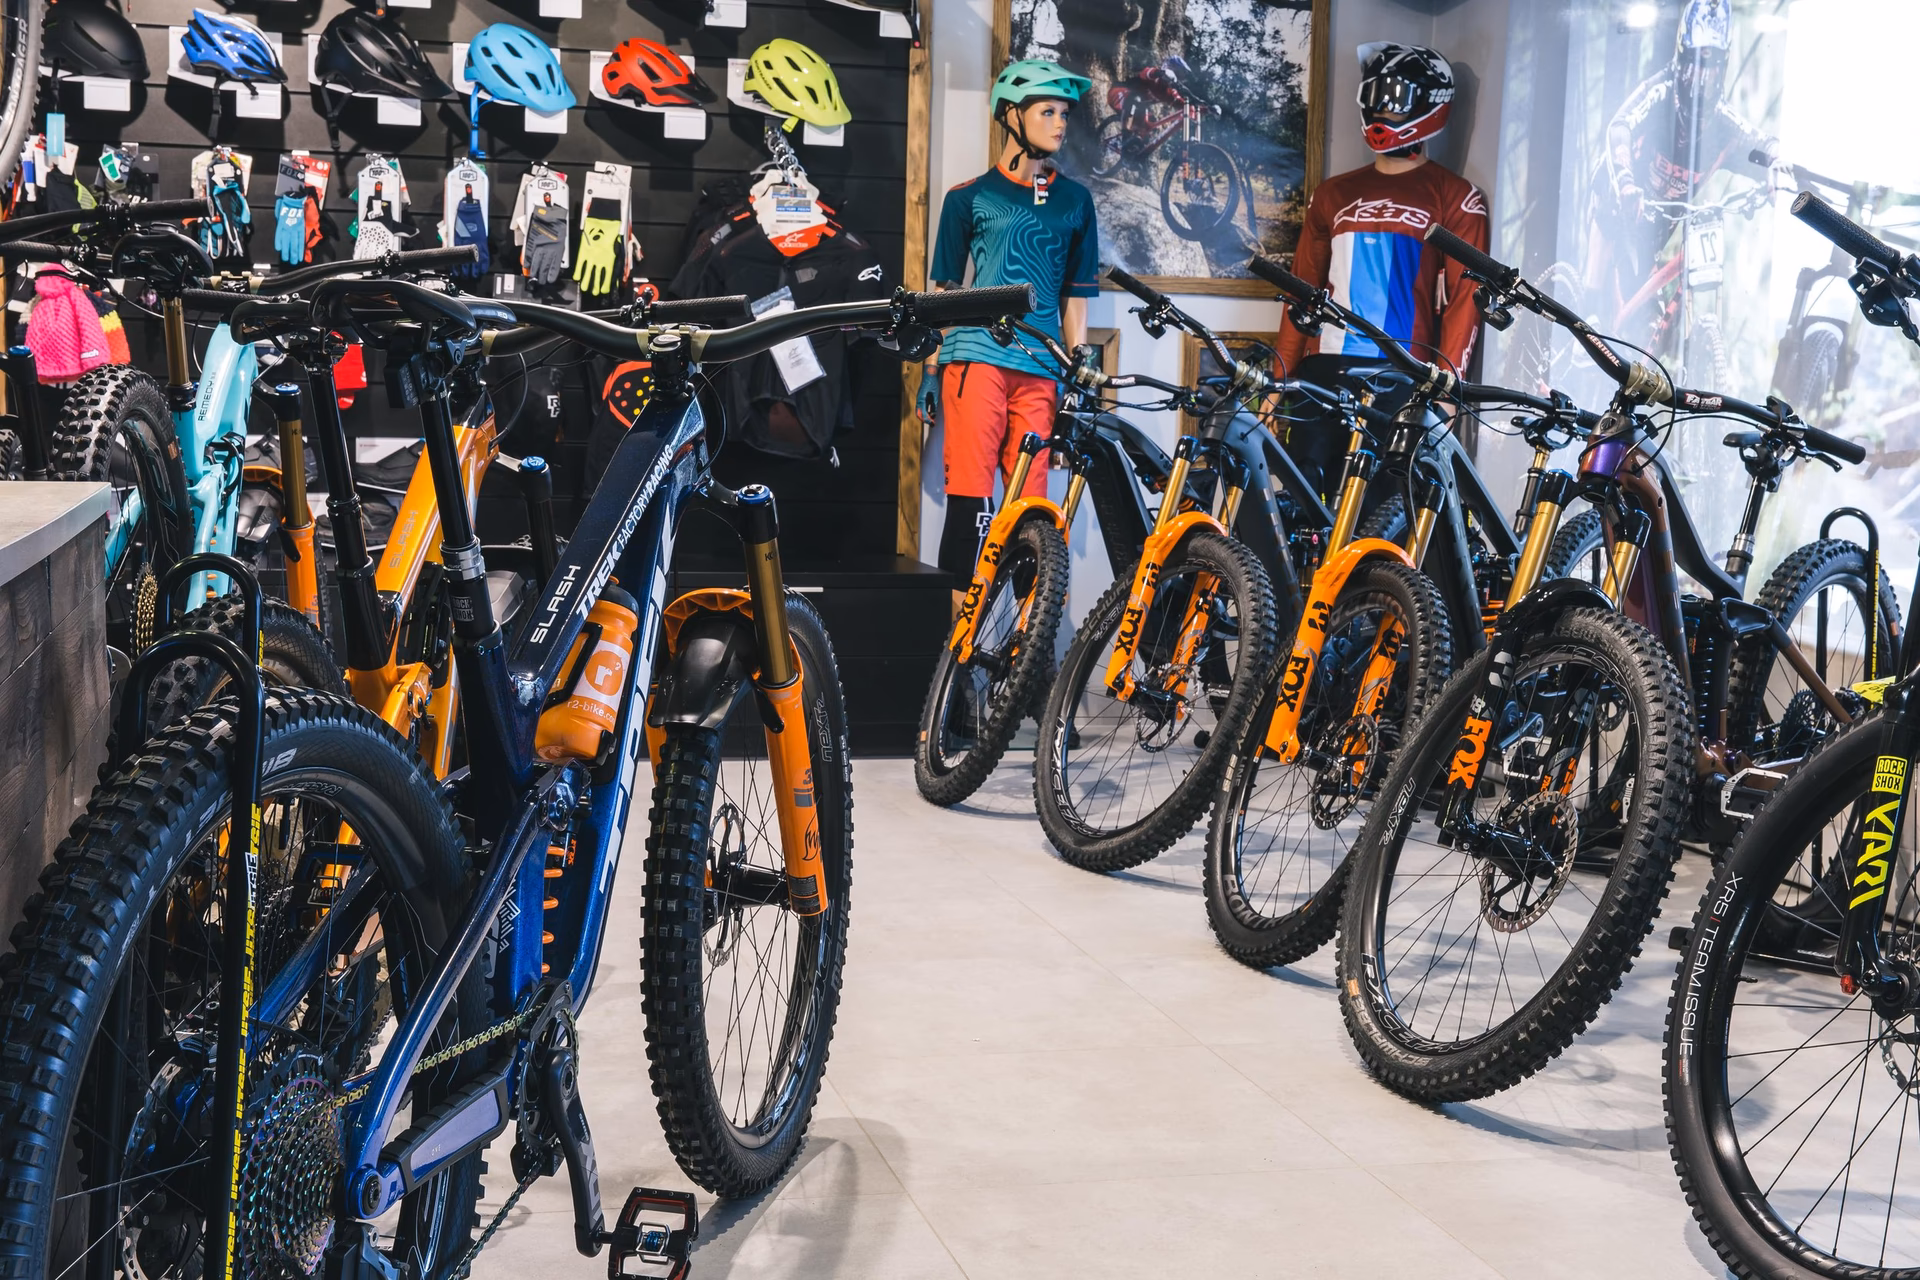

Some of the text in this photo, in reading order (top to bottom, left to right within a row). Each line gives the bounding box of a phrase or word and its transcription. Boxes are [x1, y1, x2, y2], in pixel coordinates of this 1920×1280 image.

[280, 166, 298, 178] FOX
[279, 206, 304, 218] FOX
[197, 380, 215, 422] REMEDY
[388, 509, 419, 569] SLASH
[576, 444, 675, 621] TREK FACTORY RACING
[530, 565, 582, 645] SLASH
[959, 583, 984, 625] FOX
[1080, 577, 1135, 645] SCHWAL
[1114, 606, 1144, 656] FOX
[1275, 654, 1311, 713] FOX
[1447, 715, 1493, 790] FOX
[1876, 758, 1905, 776] ROCK
[1874, 774, 1902, 791] SHOX
[567, 839, 577, 867] FOX
[1849, 800, 1901, 911] YARI
[1713, 870, 1744, 918] XR5
[1689, 924, 1721, 988] TEAM
[1351, 997, 1433, 1067] SCHWALBE
[1678, 985, 1700, 1056] ISSUE
